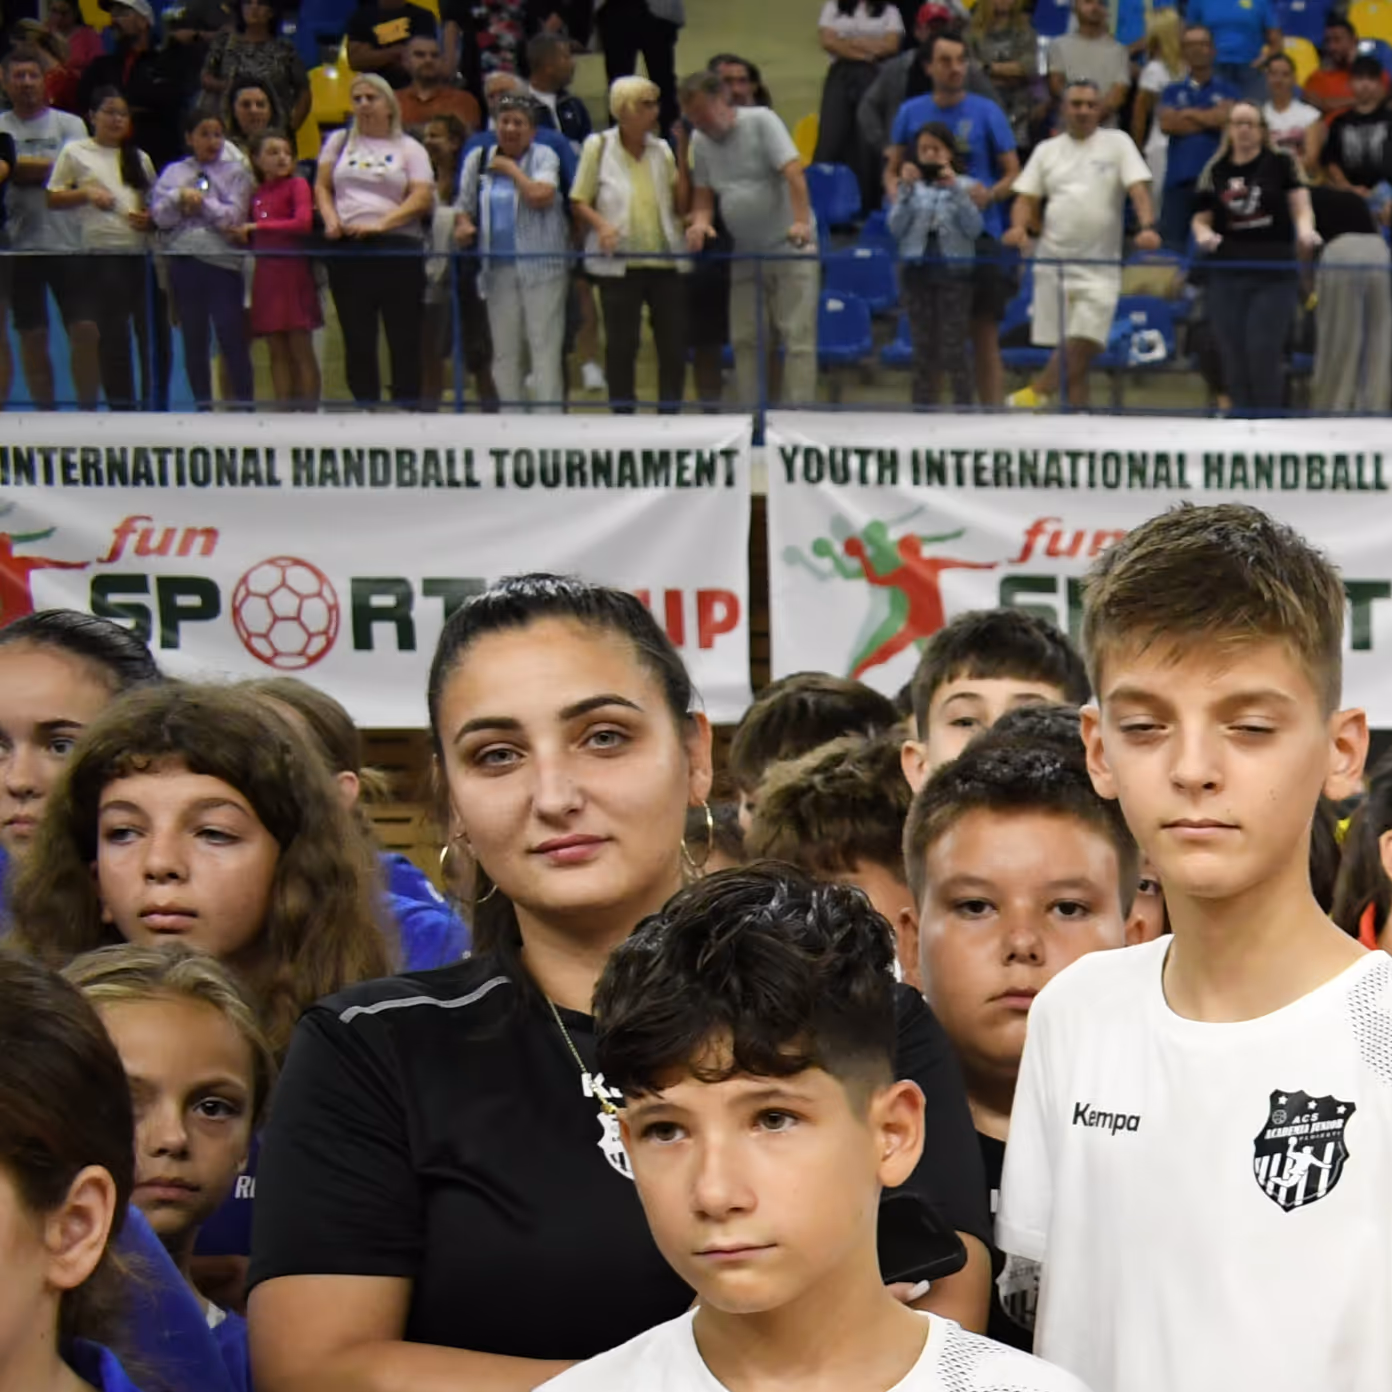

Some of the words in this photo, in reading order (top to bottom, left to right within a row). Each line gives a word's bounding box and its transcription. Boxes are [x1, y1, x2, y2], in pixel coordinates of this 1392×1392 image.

[0, 446, 281, 487] INTERNATIONAL
[291, 448, 481, 488] HANDBALL
[490, 448, 740, 489] TOURNAMENT
[778, 446, 898, 485] YOUTH
[911, 448, 1192, 489] INTERNATIONAL
[1203, 452, 1388, 491] HANDBALL
[96, 514, 220, 564] fun
[638, 588, 742, 650] UP
[1072, 1102, 1141, 1136] Kempa
